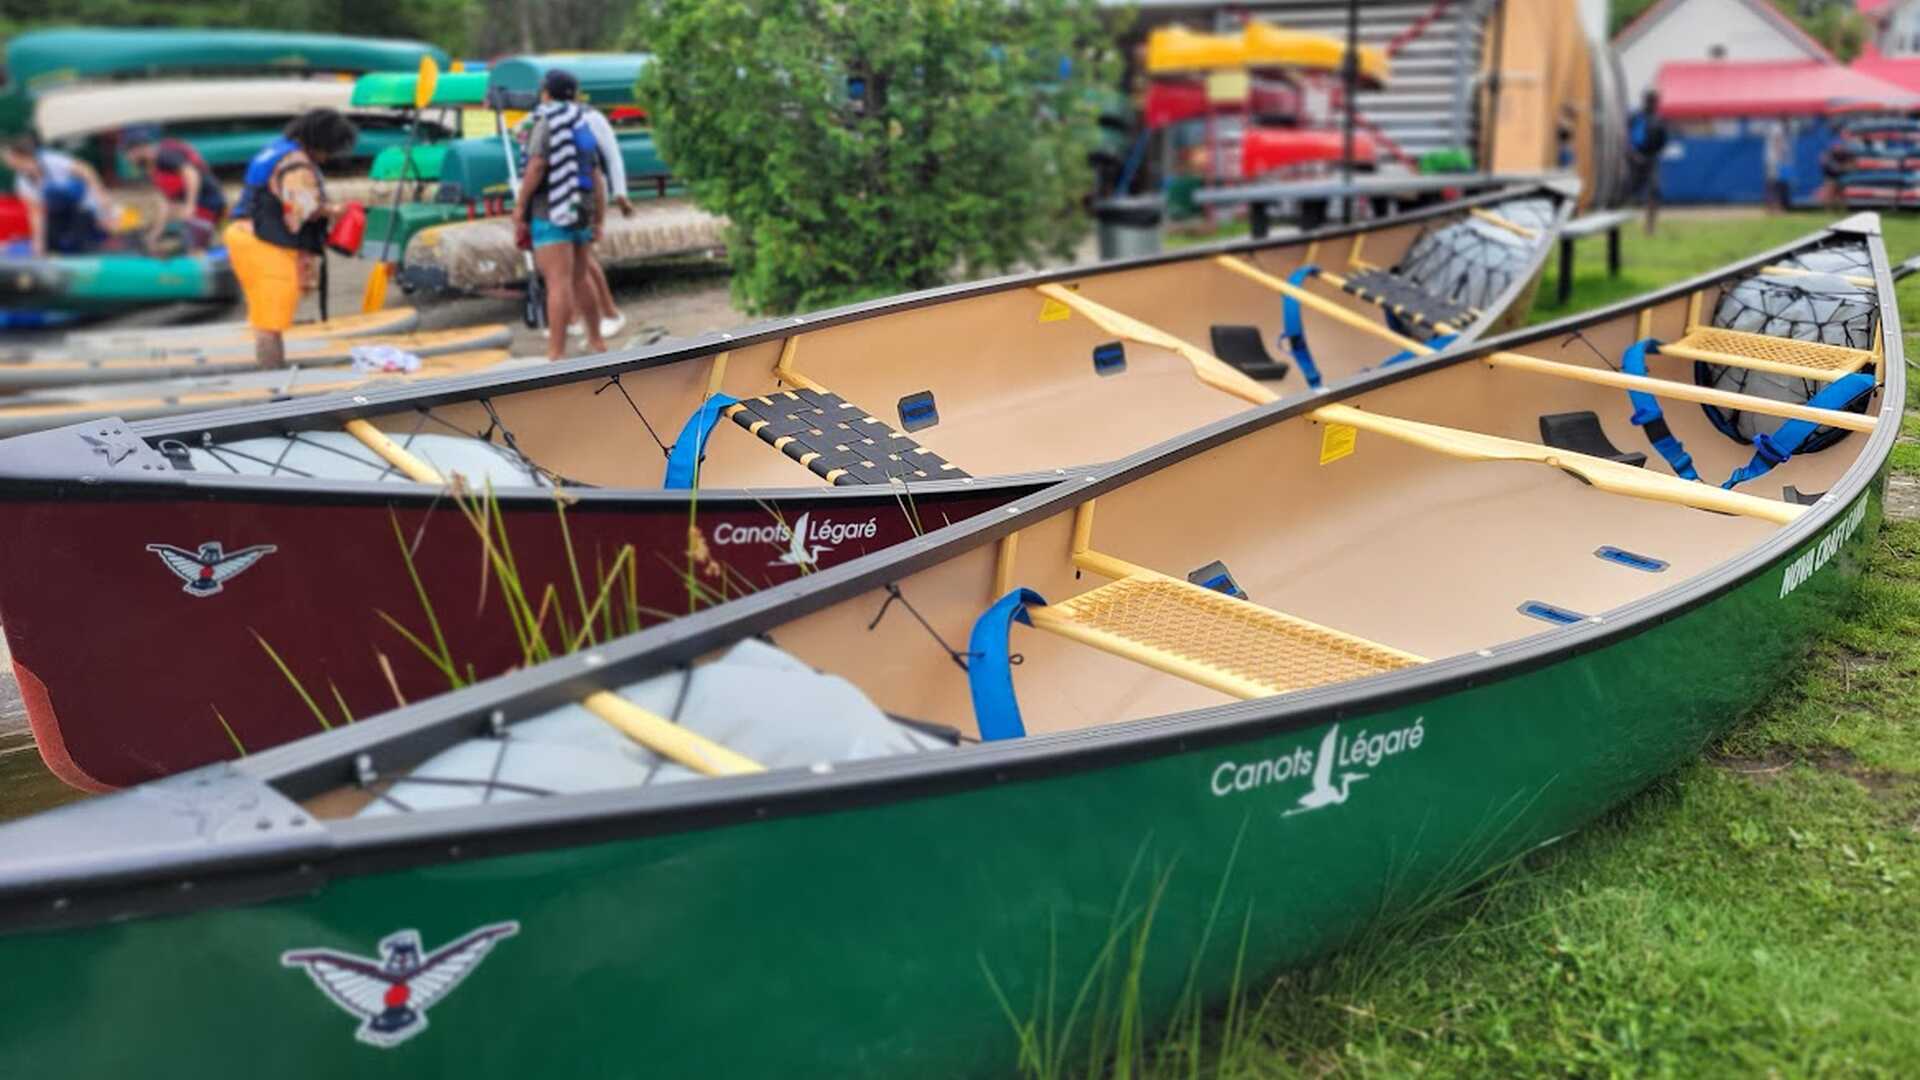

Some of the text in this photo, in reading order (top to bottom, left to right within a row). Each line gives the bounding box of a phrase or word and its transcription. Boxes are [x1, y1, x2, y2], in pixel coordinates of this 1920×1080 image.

[714, 517, 877, 545] Canots Légaré
[1780, 548, 1815, 599] NOVA
[1211, 715, 1424, 796] Canots Légaré
